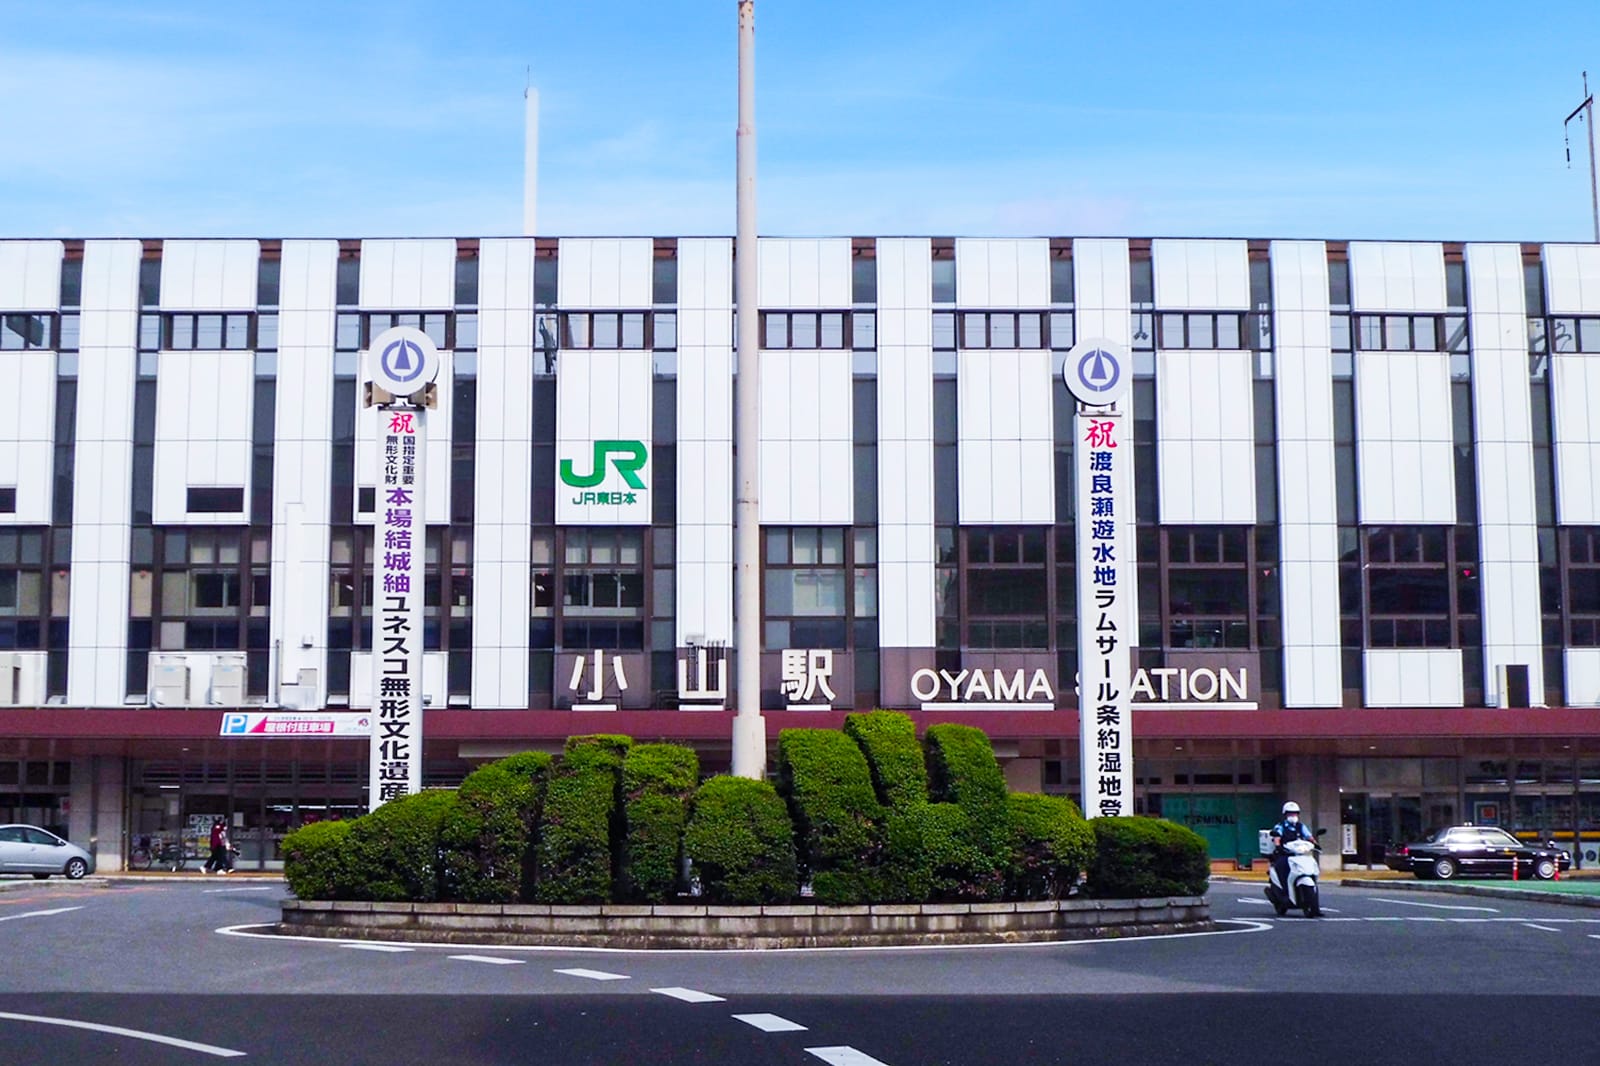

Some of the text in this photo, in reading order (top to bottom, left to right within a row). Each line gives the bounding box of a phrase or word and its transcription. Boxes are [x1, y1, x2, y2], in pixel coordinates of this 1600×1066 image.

[388, 412, 415, 434] 祝
[1084, 419, 1117, 448] 祝
[385, 436, 398, 485] 無形文化財
[402, 436, 415, 485] 国指定重要
[560, 440, 648, 489] JR
[572, 492, 637, 505] JR東日本
[569, 649, 836, 701] 小山駅
[911, 668, 1247, 700] OYAMA ATION
[226, 715, 246, 733] P
